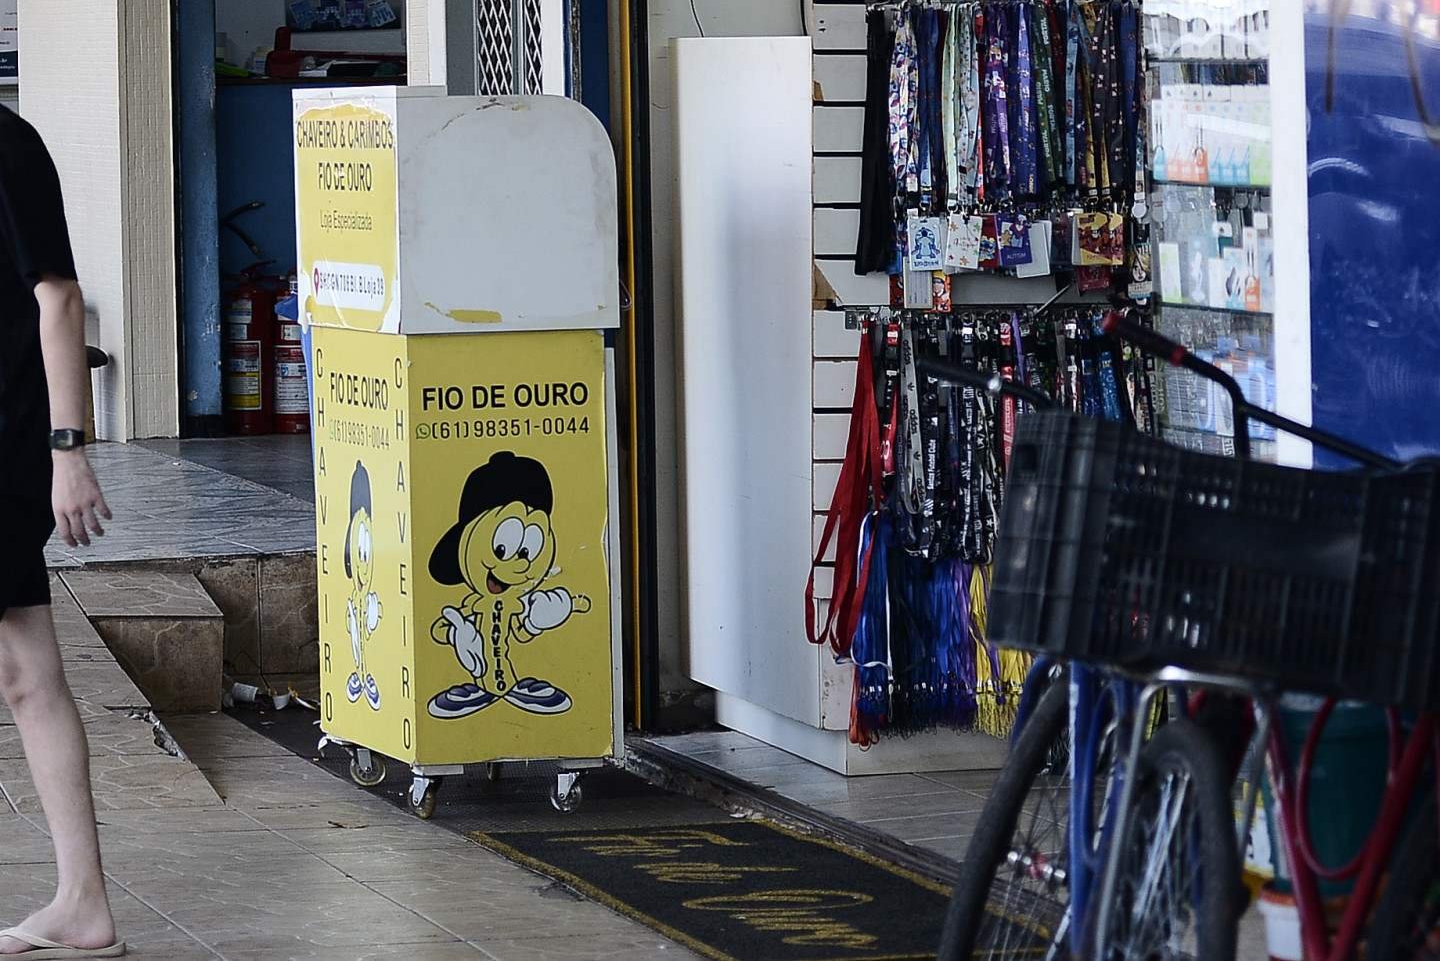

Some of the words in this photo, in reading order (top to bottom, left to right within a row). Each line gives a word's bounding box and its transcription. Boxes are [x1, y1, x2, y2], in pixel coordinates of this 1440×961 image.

[297, 119, 338, 149] CHAVEIRO
[339, 121, 347, 149] &
[347, 119, 394, 149] CARIMBOS
[318, 162, 332, 191] FIO
[333, 162, 345, 192] DE
[347, 162, 373, 192] OURO
[320, 210, 333, 233] Loja
[333, 210, 373, 233] Especializada
[329, 371, 345, 403] FIO
[345, 374, 359, 406] DE
[360, 378, 389, 411] OURO
[421, 385, 464, 412] FIO
[471, 384, 506, 410] DE
[513, 381, 589, 408] OURO
[431, 416, 590, 441] (61)98351-0044
[315, 347, 334, 724] CHAVEIRO
[393, 356, 412, 751] CHAVEIRO
[491, 599, 508, 692] CHAVEIRO
